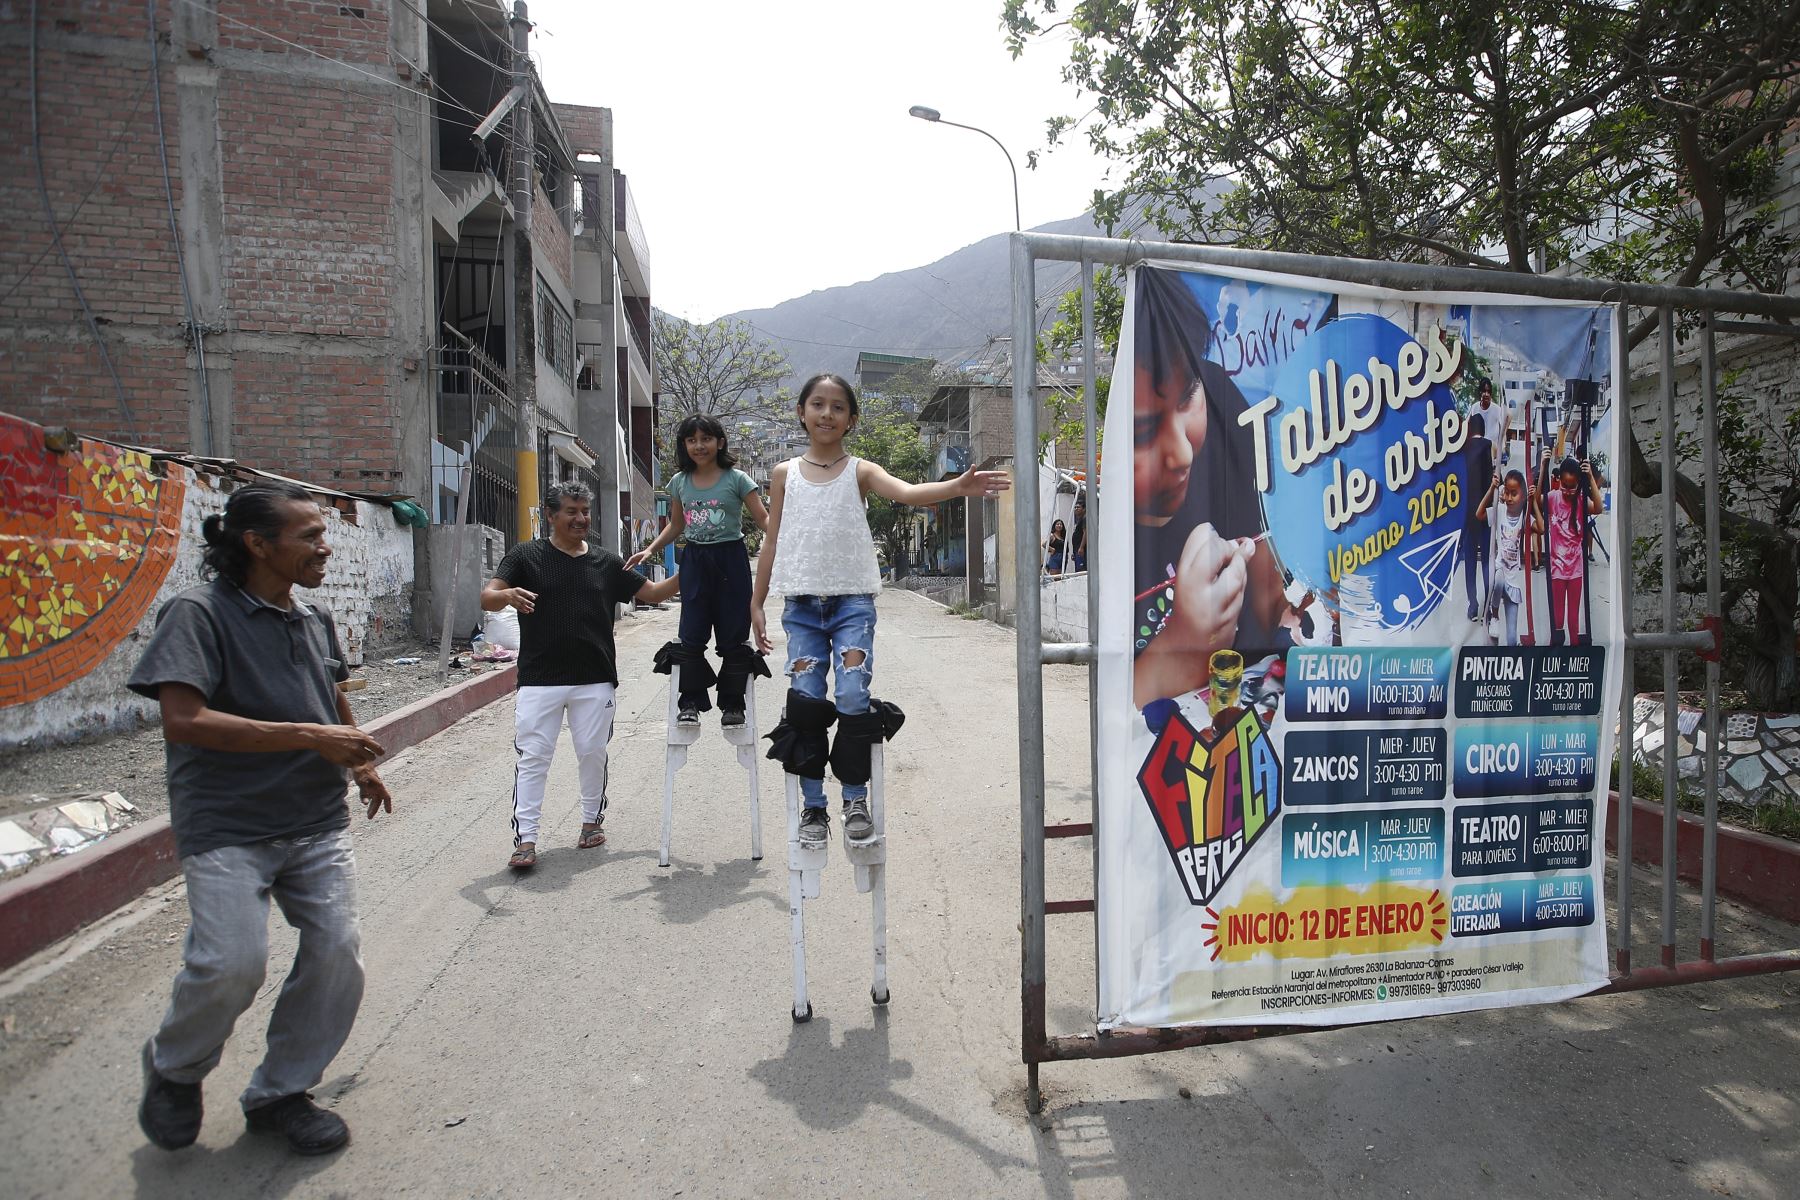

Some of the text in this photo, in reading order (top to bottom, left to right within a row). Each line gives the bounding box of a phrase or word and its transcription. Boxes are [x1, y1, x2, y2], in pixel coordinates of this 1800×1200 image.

[1237, 324, 1462, 492] Talleres
[1322, 400, 1470, 531] de arte
[1327, 473, 1461, 585] Verano 2026
[1298, 654, 1362, 681] TEATRO
[1381, 658, 1400, 675] LUN
[1410, 658, 1434, 675] MIER
[1462, 656, 1524, 681] PINTURA
[1542, 657, 1560, 673] LUN
[1568, 656, 1590, 673] MIER
[1306, 686, 1350, 714] MIMO
[1372, 684, 1444, 704] 10:00-11:30 AM
[1476, 681, 1511, 698] MÁSCARAS
[1534, 682, 1574, 700] 3:00-4:30
[1380, 738, 1403, 755] MIER
[1411, 736, 1436, 754] JUEV
[1541, 734, 1557, 750] LUN
[1565, 732, 1586, 749] MAR
[1292, 755, 1359, 782] ZANCOS
[1466, 742, 1520, 774] CIRCO
[1534, 758, 1576, 777] 3:00-4:30
[1373, 764, 1420, 784] 3:00-4:30
[1380, 819, 1400, 836] MAR
[1539, 810, 1556, 827] MAR
[1565, 808, 1588, 825] MIER
[1460, 814, 1520, 844] TEATRO
[1294, 822, 1360, 860] MÚSICA
[1533, 834, 1574, 855] 6:00-8:00
[1371, 842, 1417, 863] 3:00-4:30
[1461, 845, 1517, 866] PARA JOVÉNES
[1451, 888, 1502, 912] CREACIÓN
[1538, 883, 1554, 898] MAR
[1561, 881, 1584, 896] JUEV
[1451, 912, 1501, 933] LITERARIA
[1535, 904, 1568, 920] 4:00-5:30
[1228, 902, 1425, 946] INICIO: 12 DE ENERO
[1212, 986, 1252, 1000] Referencia:
[1252, 984, 1283, 996] Estación
[1284, 981, 1315, 995] Naranjal
[1316, 980, 1328, 990] del
[1328, 976, 1377, 990] metropolitano
[1451, 966, 1482, 980] paradero
[1482, 962, 1501, 975] César
[1502, 962, 1524, 974] Vallejo
[1291, 968, 1315, 982] Lugar:
[1316, 968, 1328, 978] Av.
[1329, 963, 1365, 977] Miraflores
[1366, 962, 1385, 973] 2630
[1385, 962, 1394, 972] La
[1261, 989, 1375, 1010] INSCRIPCIONES-INFORMES:
[1437, 978, 1481, 993] 997303960
